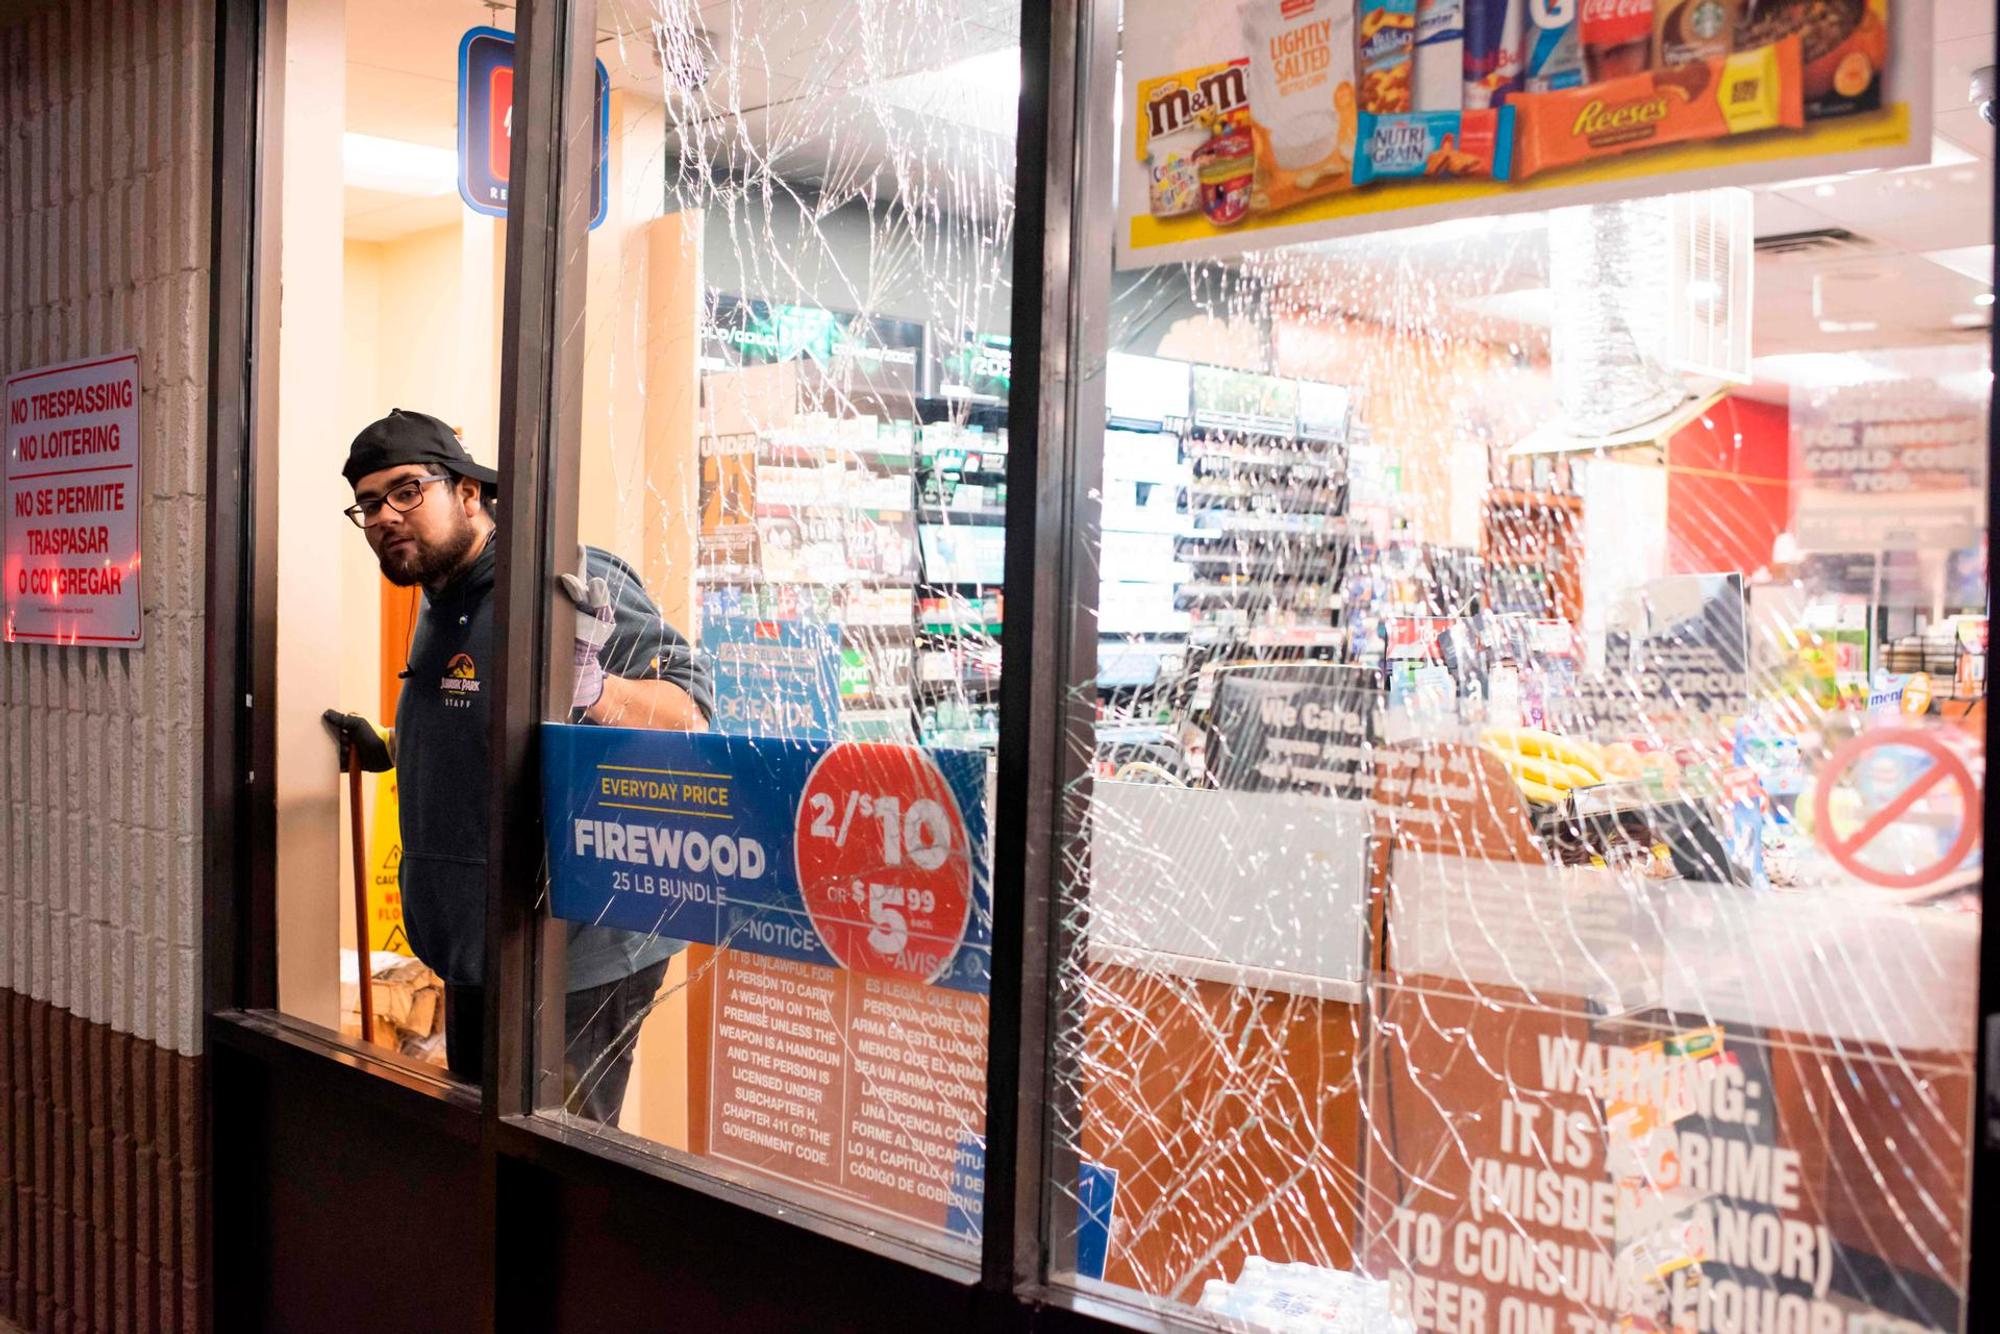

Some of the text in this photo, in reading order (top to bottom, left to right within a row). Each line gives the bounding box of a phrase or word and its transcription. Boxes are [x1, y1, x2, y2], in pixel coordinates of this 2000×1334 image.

[1270, 16, 1331, 61] LIGHTLY
[1273, 45, 1330, 84] SALTED
[1373, 145, 1424, 163] GRAIN
[1375, 128, 1425, 147] NUTRI
[12, 379, 132, 424] NO TRESPASSING
[20, 424, 120, 461] NO LOITERING
[16, 483, 124, 517] NO SE PERMITE
[27, 526, 109, 555] TRASPASAR
[19, 567, 121, 595] O CONGREGAR
[445, 699, 470, 708] STAFF
[1261, 698, 1297, 728] We
[602, 777, 729, 806] EVERYDAY PRICE
[574, 818, 766, 880] FIREWOOD
[612, 871, 728, 906] 25 LB BUNDLE
[730, 949, 834, 982] IT IS UNLAWFUL FOR
[727, 968, 834, 1003] A PERSON TO CARRY
[865, 978, 880, 993] ES
[883, 981, 924, 1004] ILEGAL
[731, 988, 831, 1023] A WEAPON ON THIS
[863, 998, 919, 1023] PERSONA
[724, 1005, 837, 1045] PREMISE UNLESS THE
[851, 1017, 886, 1037] ARMA
[907, 1029, 938, 1050] ESTE
[719, 1023, 840, 1067] WEAPON IS A HANDGUN
[859, 1039, 901, 1062] MENOS
[903, 1050, 929, 1068] QUE
[931, 1057, 946, 1074] EL
[727, 1046, 830, 1085] AND THE PERSON IS
[854, 1059, 877, 1078] SEA
[879, 1065, 896, 1080] UN
[898, 1070, 934, 1092] ARMA
[1538, 1033, 1762, 1126] WARNING:
[732, 1066, 823, 1104] LICENSED UNDER
[735, 1086, 818, 1124] SUBCHAPTER H,
[861, 1102, 886, 1122] UNA
[862, 1081, 979, 1126] LA PERSONA TENGA
[722, 1122, 794, 1155] GOVERNMENT
[723, 1102, 831, 1147] CHAPTER 411 OF THE
[852, 1120, 893, 1144] FORME
[894, 1132, 909, 1149] AL
[1501, 1098, 1541, 1157] IT
[1552, 1108, 1594, 1168] IS
[848, 1140, 863, 1156] LO
[850, 1159, 896, 1188] CÓDIGO
[898, 1176, 914, 1193] DE
[1393, 1206, 1442, 1267] TO
[1469, 1157, 1833, 1300] (MISDEANOR)
[1388, 1269, 1487, 1334] BEER
